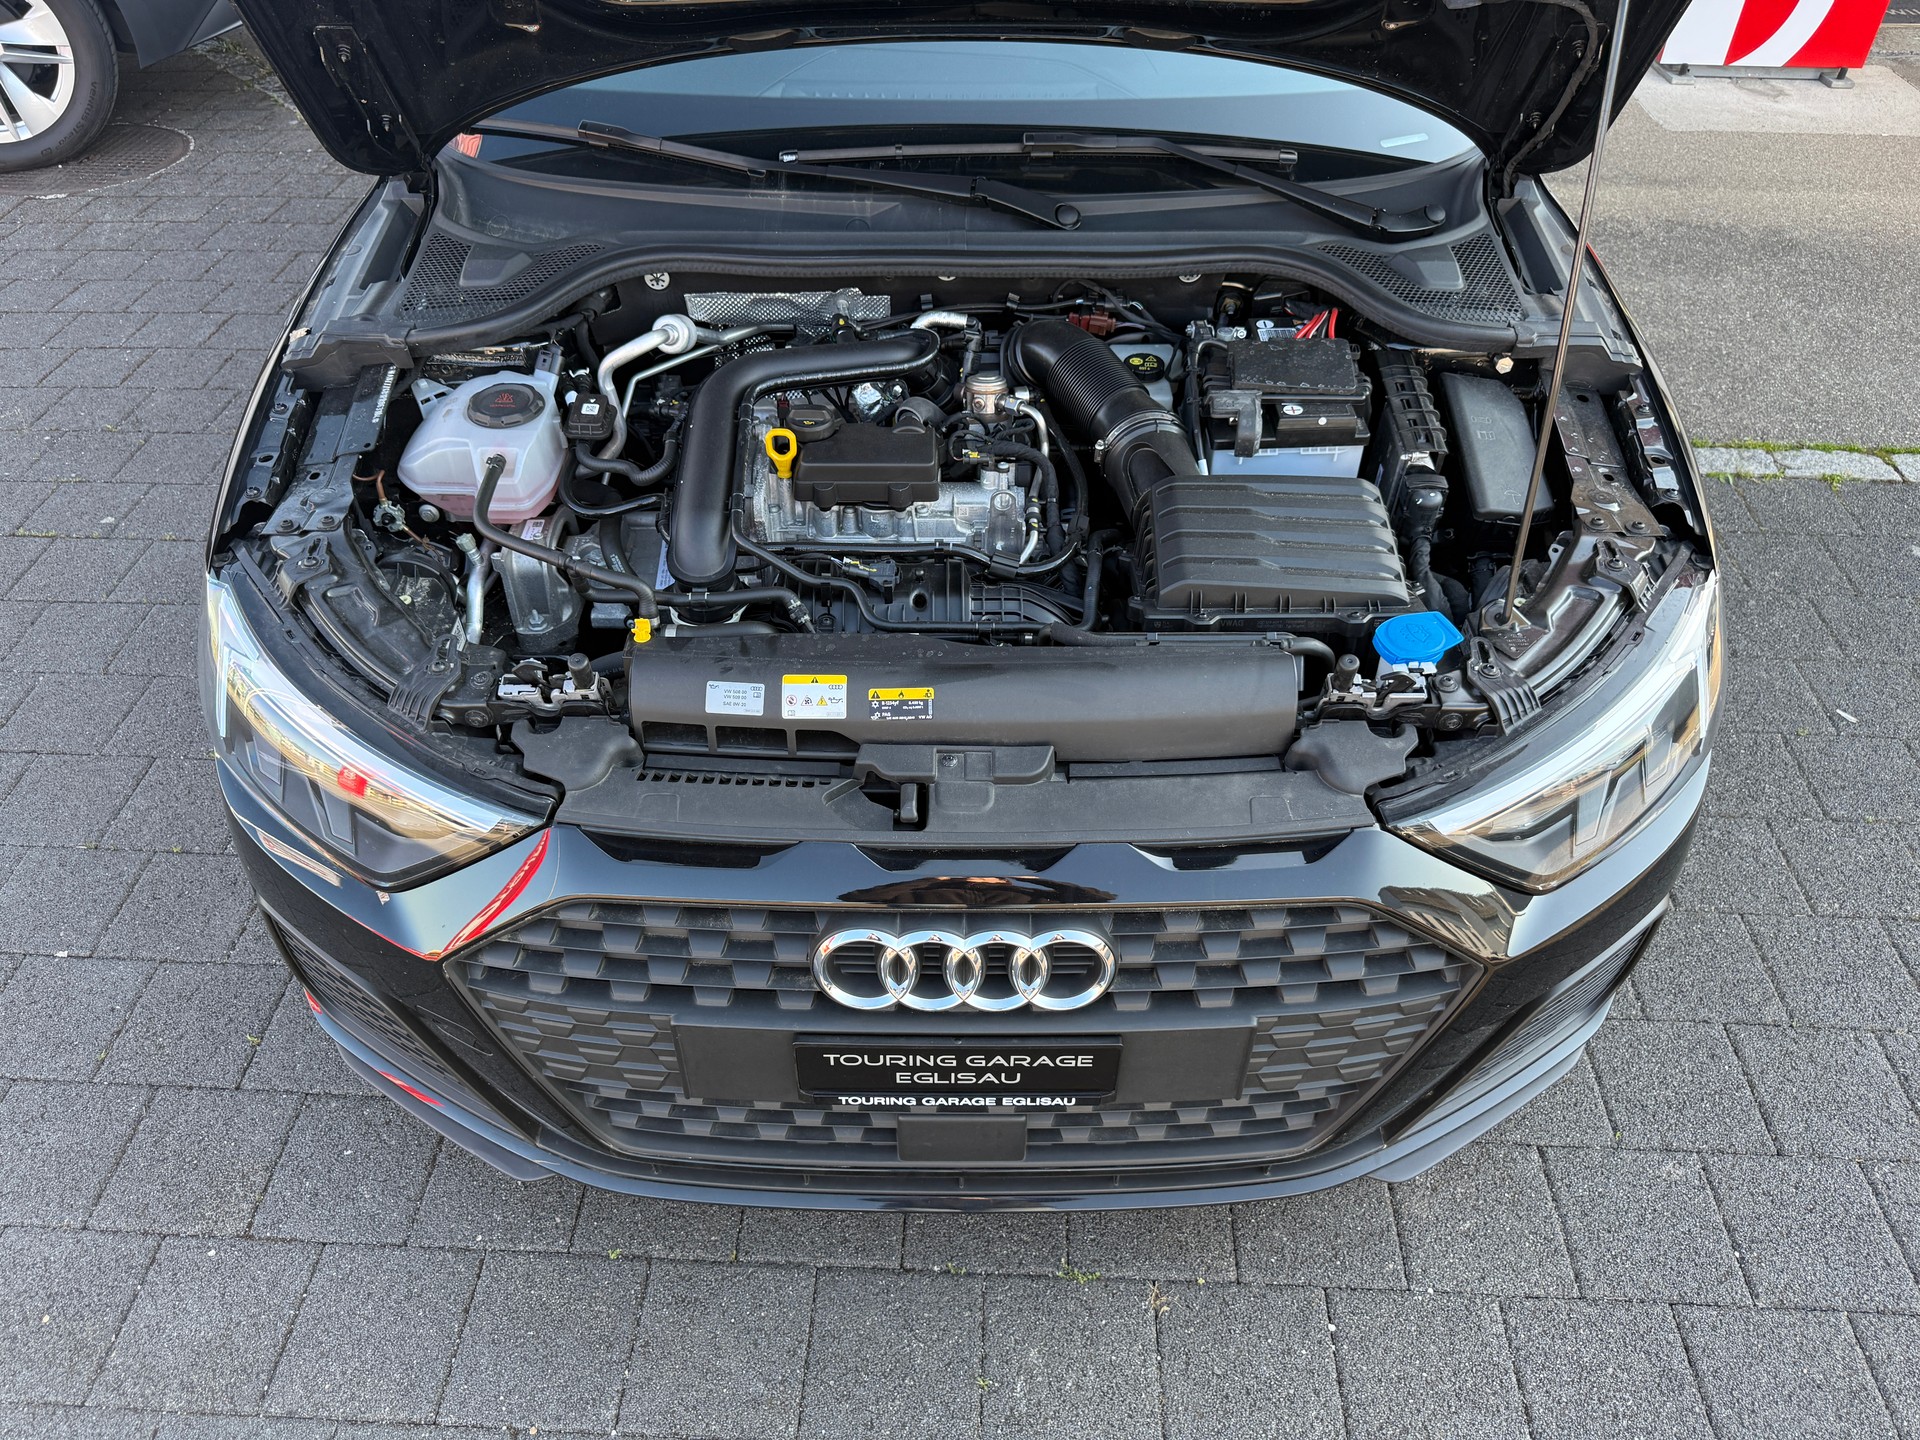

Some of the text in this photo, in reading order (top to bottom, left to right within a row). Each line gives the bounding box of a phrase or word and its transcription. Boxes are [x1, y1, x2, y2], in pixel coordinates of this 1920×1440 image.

[823, 1054, 1094, 1067] TOURING GARAGE
[896, 1072, 1021, 1084] EGLISAU
[838, 1096, 1076, 1106] TOURING GARAGE EGLISAU
